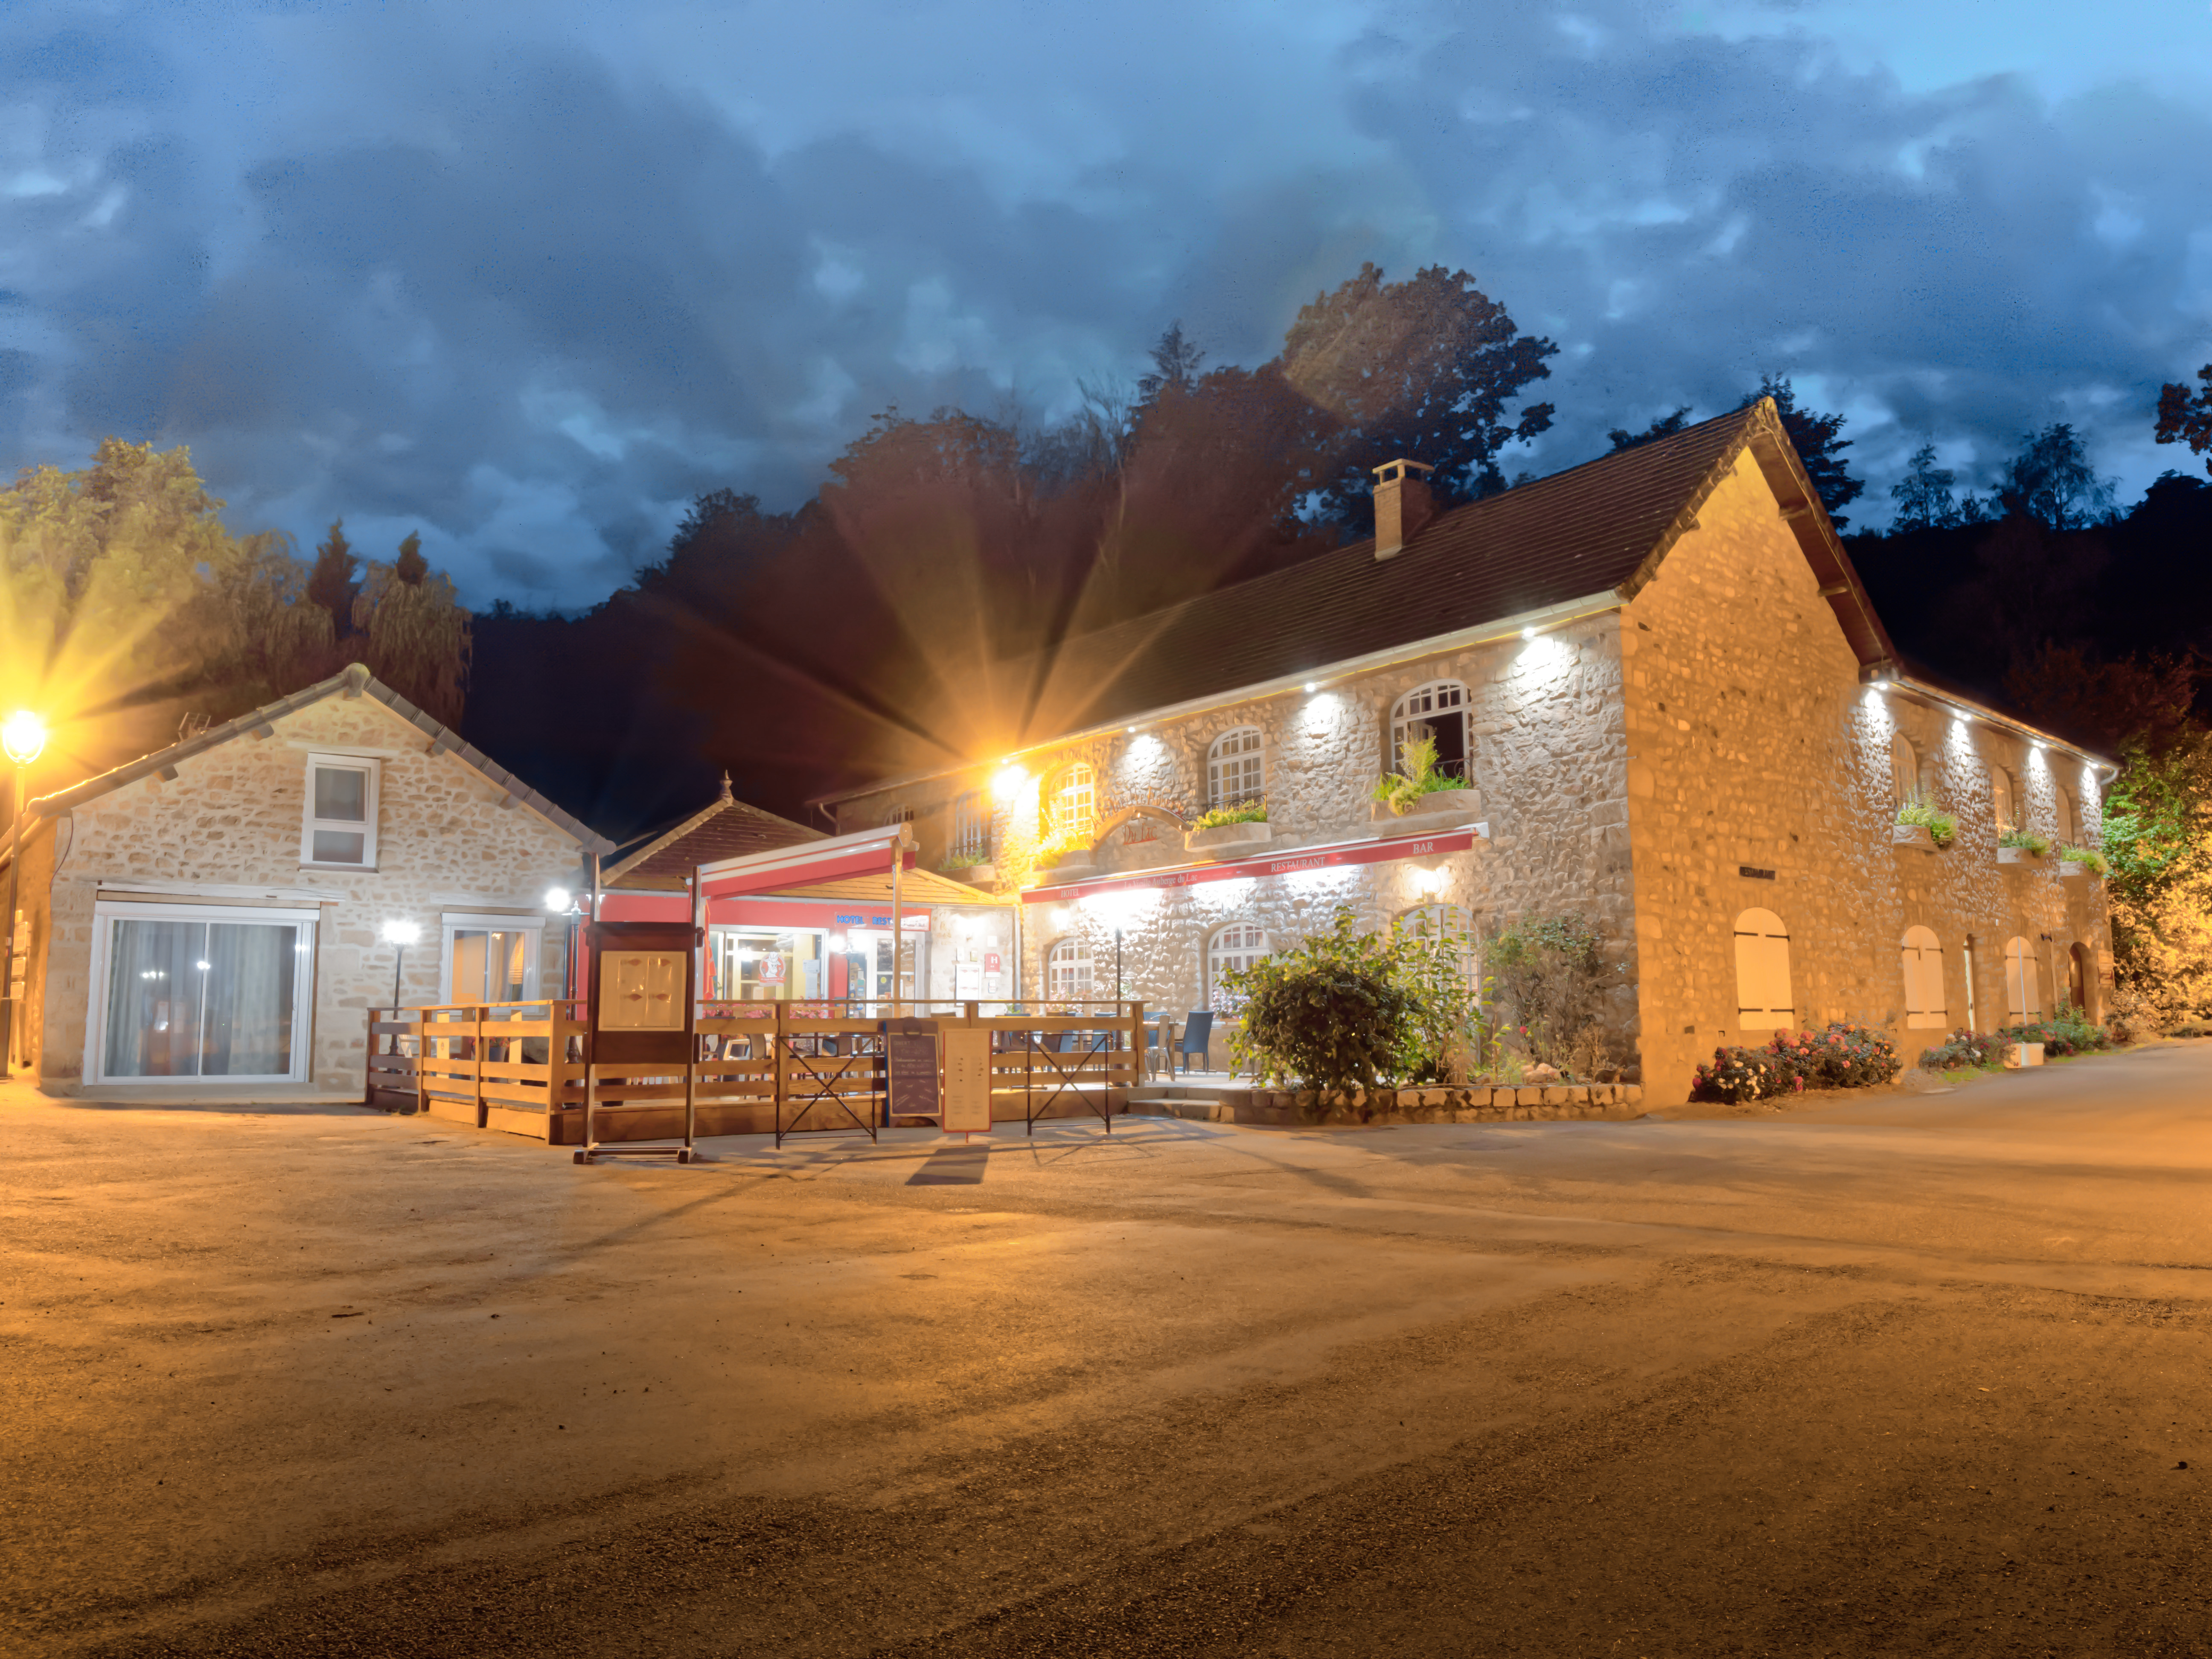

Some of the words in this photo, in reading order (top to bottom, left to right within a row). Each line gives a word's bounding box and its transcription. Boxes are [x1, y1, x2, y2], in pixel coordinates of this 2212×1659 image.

[1061, 888, 1080, 898] HOTEL
[1133, 878, 1151, 888] Vieille
[1153, 876, 1176, 886] Auberge
[1178, 874, 1185, 883] du
[1186, 873, 1198, 882] Lac
[1271, 857, 1325, 872] RESTAURANT
[1413, 841, 1434, 854] BAR
[837, 915, 864, 925] HOTEL
